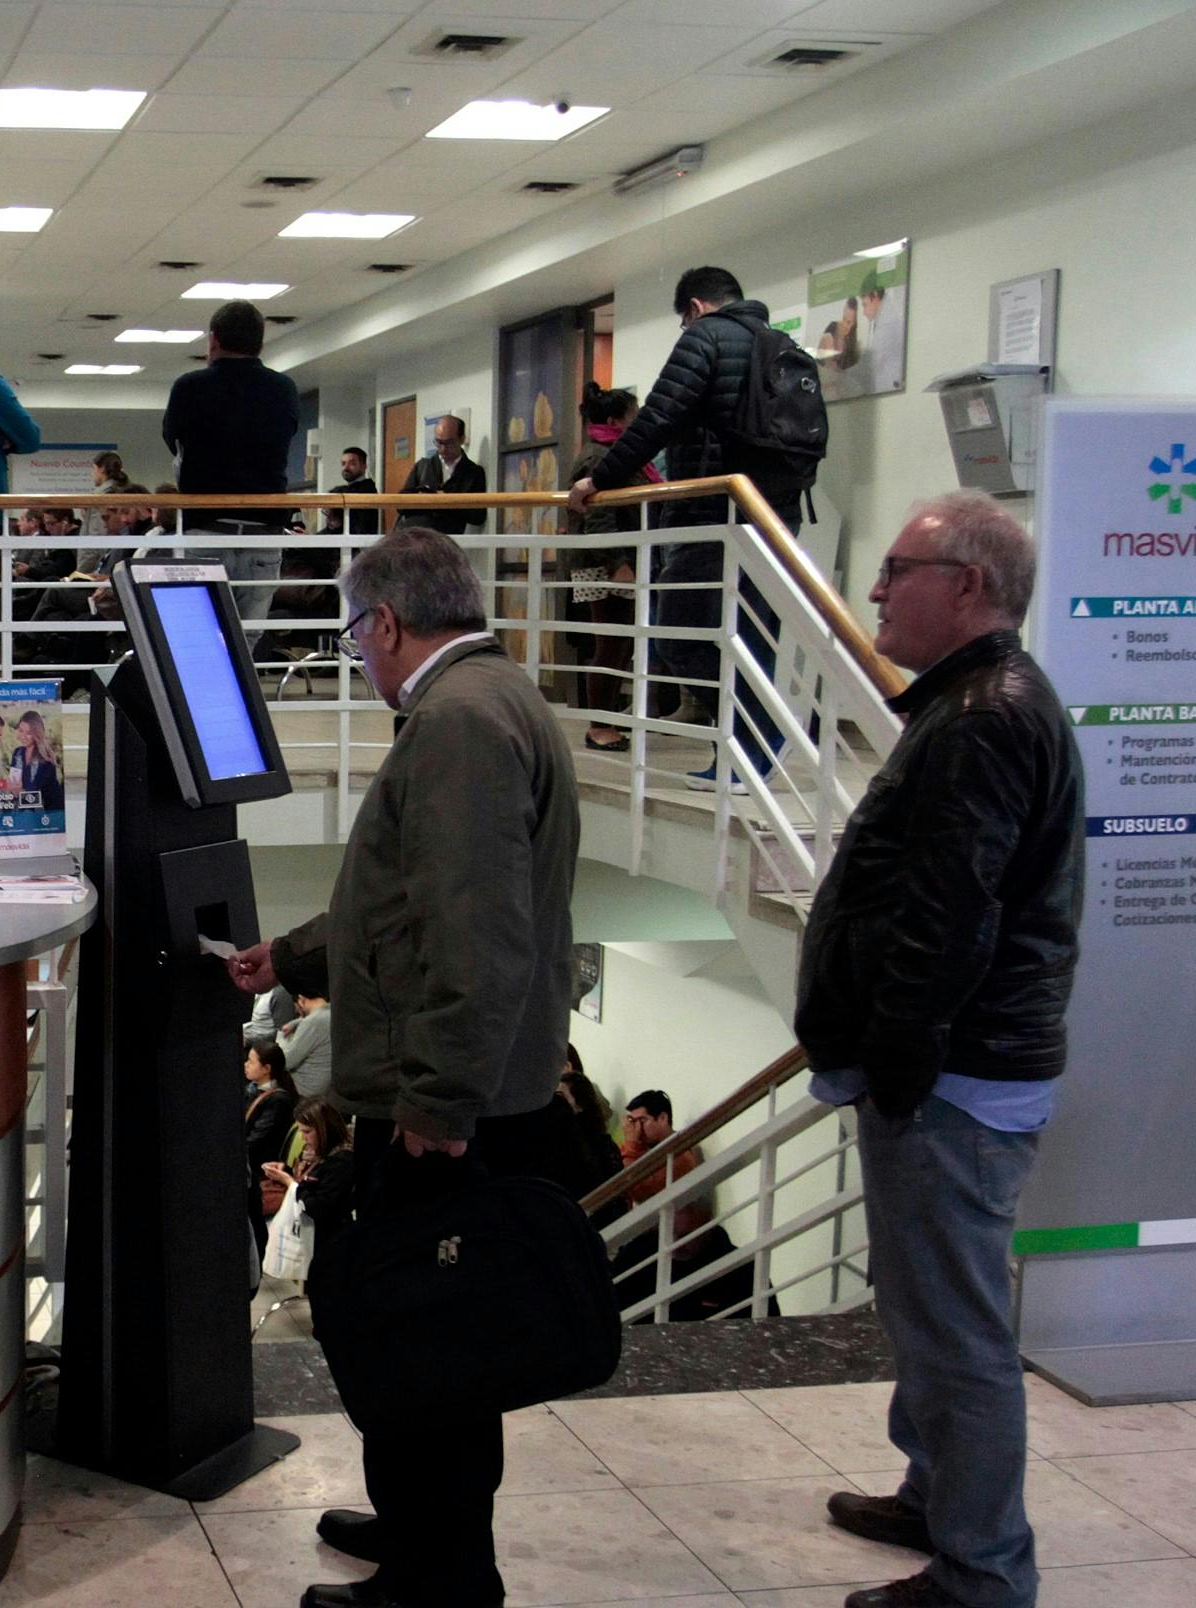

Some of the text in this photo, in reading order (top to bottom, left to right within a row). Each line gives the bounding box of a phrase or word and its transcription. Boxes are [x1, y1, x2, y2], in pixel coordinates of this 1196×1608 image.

[1112, 600, 1178, 615] PLANTA
[1126, 630, 1169, 643] Bonos
[1109, 706, 1174, 721] PLANTA
[1121, 736, 1194, 752] Programas
[1120, 773, 1136, 785] de
[1103, 818, 1187, 834] SUBSUELO
[1116, 858, 1176, 871] Licencias
[1115, 877, 1185, 889] Cobranzas
[1114, 895, 1166, 911] Entrega
[1170, 894, 1186, 906] de
